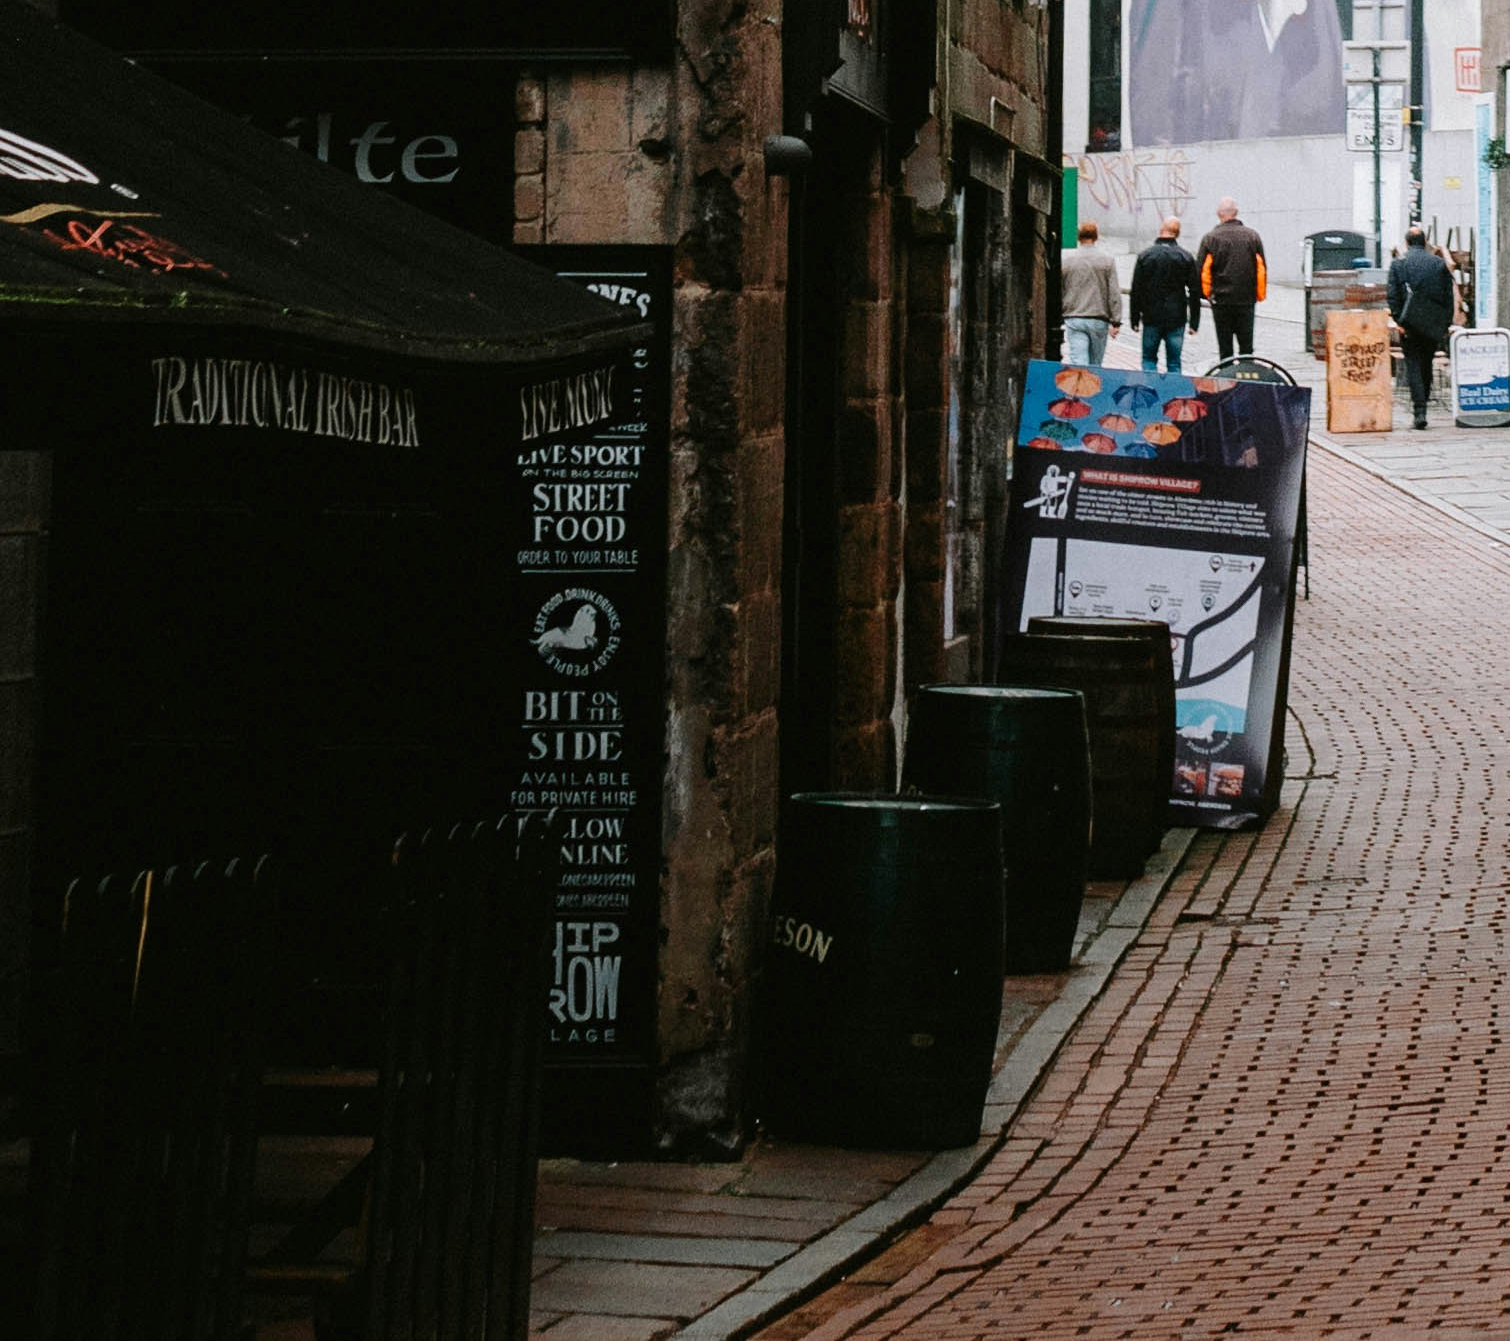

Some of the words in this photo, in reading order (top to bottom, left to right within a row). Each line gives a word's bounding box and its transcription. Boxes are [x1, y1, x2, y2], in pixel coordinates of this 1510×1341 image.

[152, 356, 310, 432] TRADITIONAL
[314, 372, 373, 444] IRISH
[376, 383, 420, 448] BAR
[519, 379, 562, 441] LIVE
[570, 444, 646, 466] SPORT
[543, 468, 569, 478] THE
[570, 470, 592, 479] BIG
[593, 470, 639, 479] SCREEN
[532, 482, 632, 512] STREET
[533, 515, 627, 543] FOOD
[517, 550, 552, 565] ORDER
[554, 550, 569, 565] TO
[571, 550, 601, 565] YOUR
[603, 550, 639, 565] TABLE
[524, 690, 586, 721] BIT
[591, 691, 619, 706] ON
[587, 707, 623, 721] THE
[527, 731, 623, 761] SIDE
[520, 771, 631, 786] AVAILABLE
[511, 790, 537, 806] FOR
[540, 790, 598, 806] PRIVATE
[601, 790, 639, 807] HIRE
